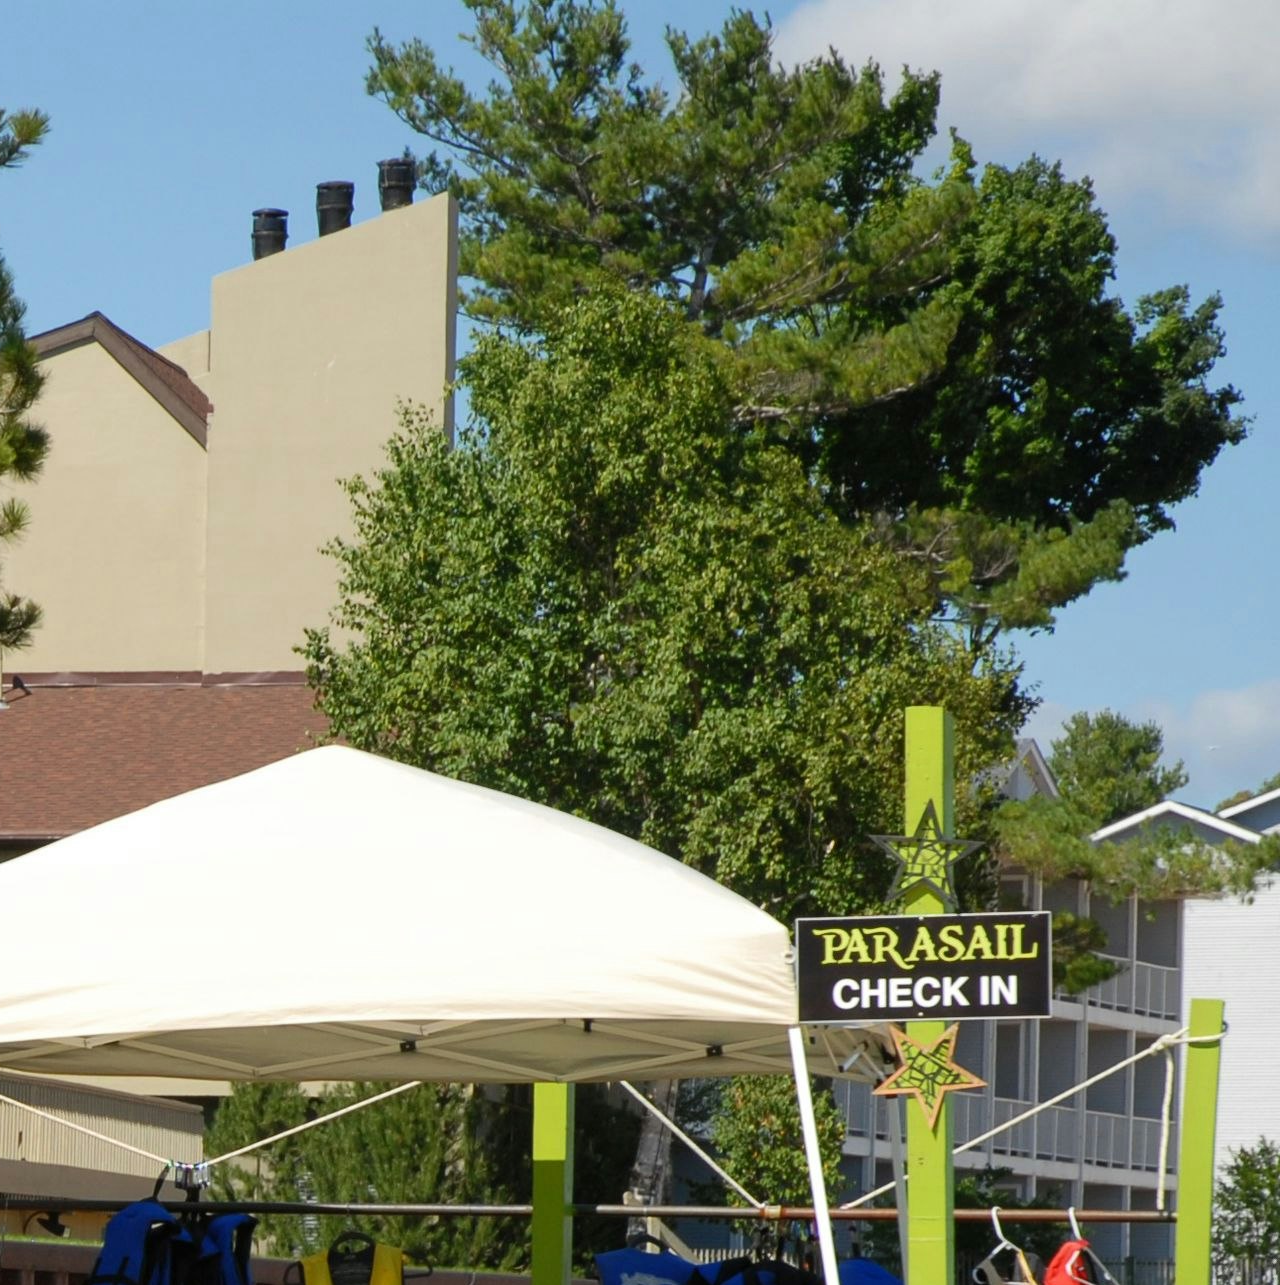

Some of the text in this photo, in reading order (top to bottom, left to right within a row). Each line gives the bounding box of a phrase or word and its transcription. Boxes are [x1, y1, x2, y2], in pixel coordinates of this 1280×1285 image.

[812, 923, 1039, 971] PARASAIL
[832, 974, 1018, 1010] CHECK IN
